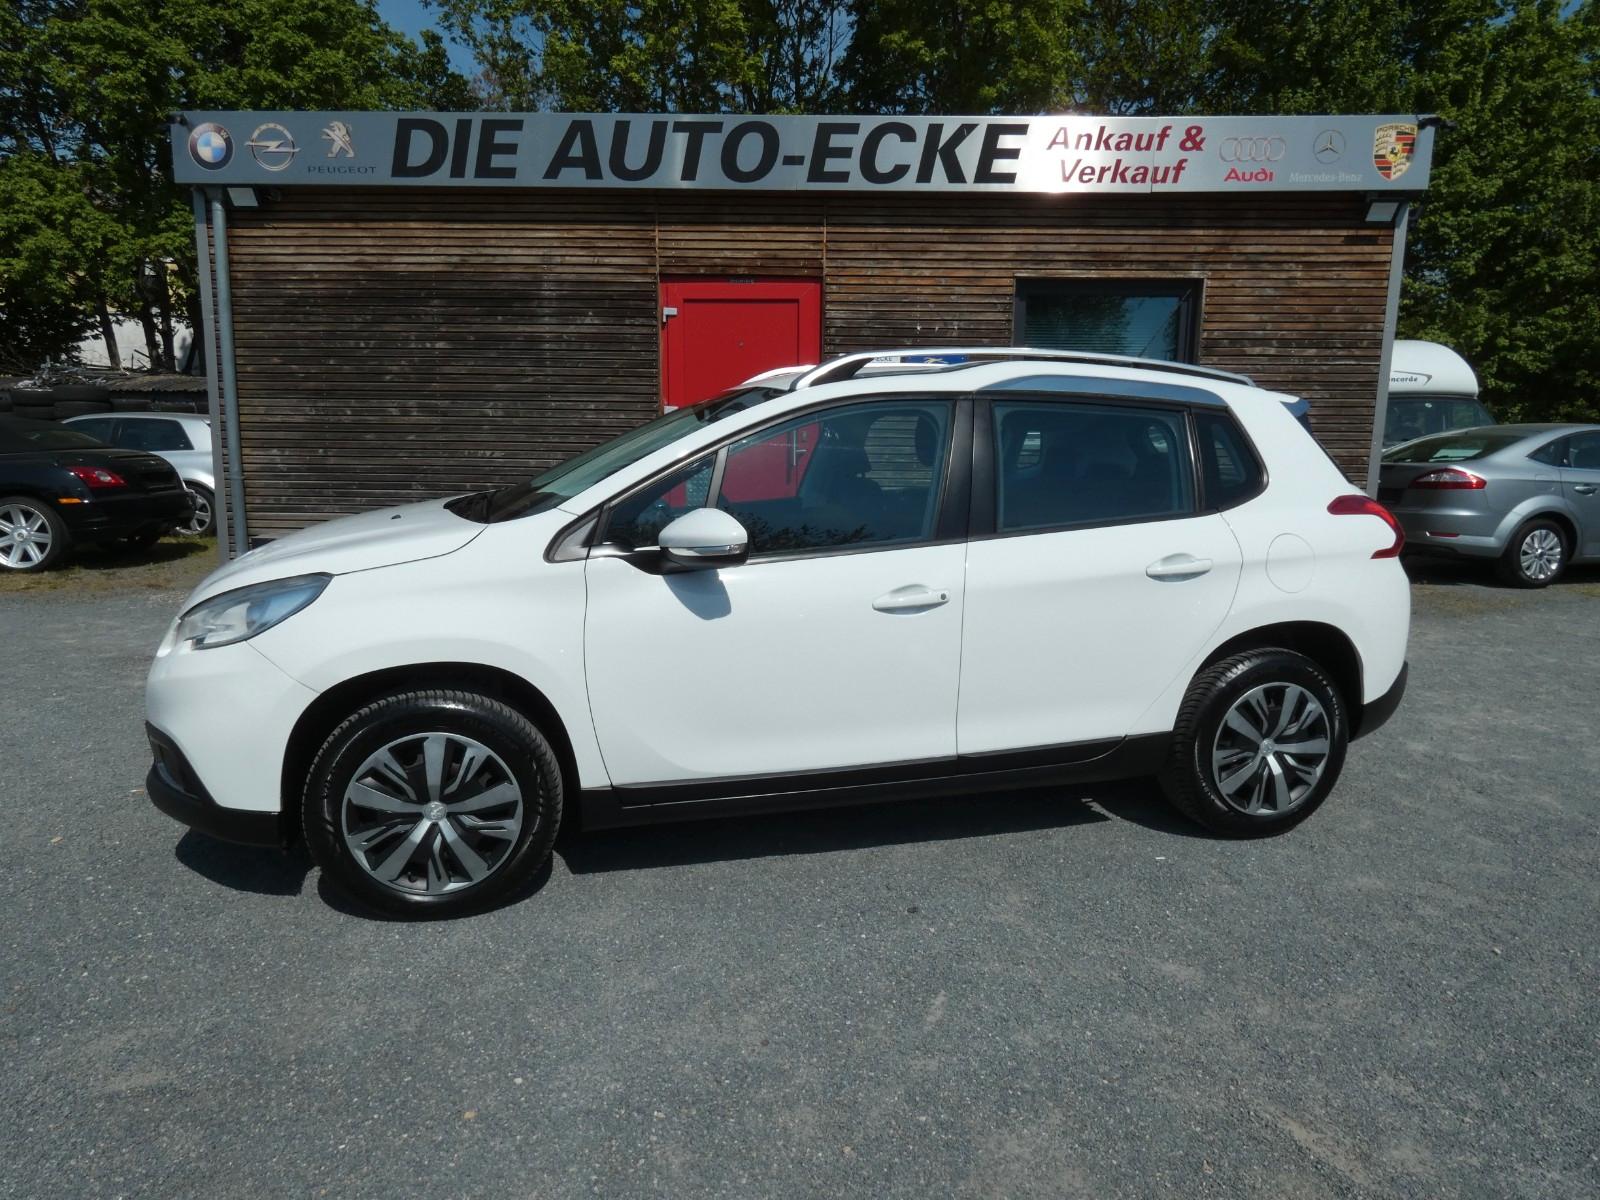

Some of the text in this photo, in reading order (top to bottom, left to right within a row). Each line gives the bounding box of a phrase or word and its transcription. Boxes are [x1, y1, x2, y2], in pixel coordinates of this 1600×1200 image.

[1047, 125, 1206, 152] Ankauf &
[391, 118, 1029, 184] DIE AUTO-ECKE
[307, 166, 377, 174] PEUGEOT
[1060, 158, 1189, 184] Verkauf
[1224, 167, 1274, 182] Audi
[1289, 171, 1363, 183] Mercedes-Benz
